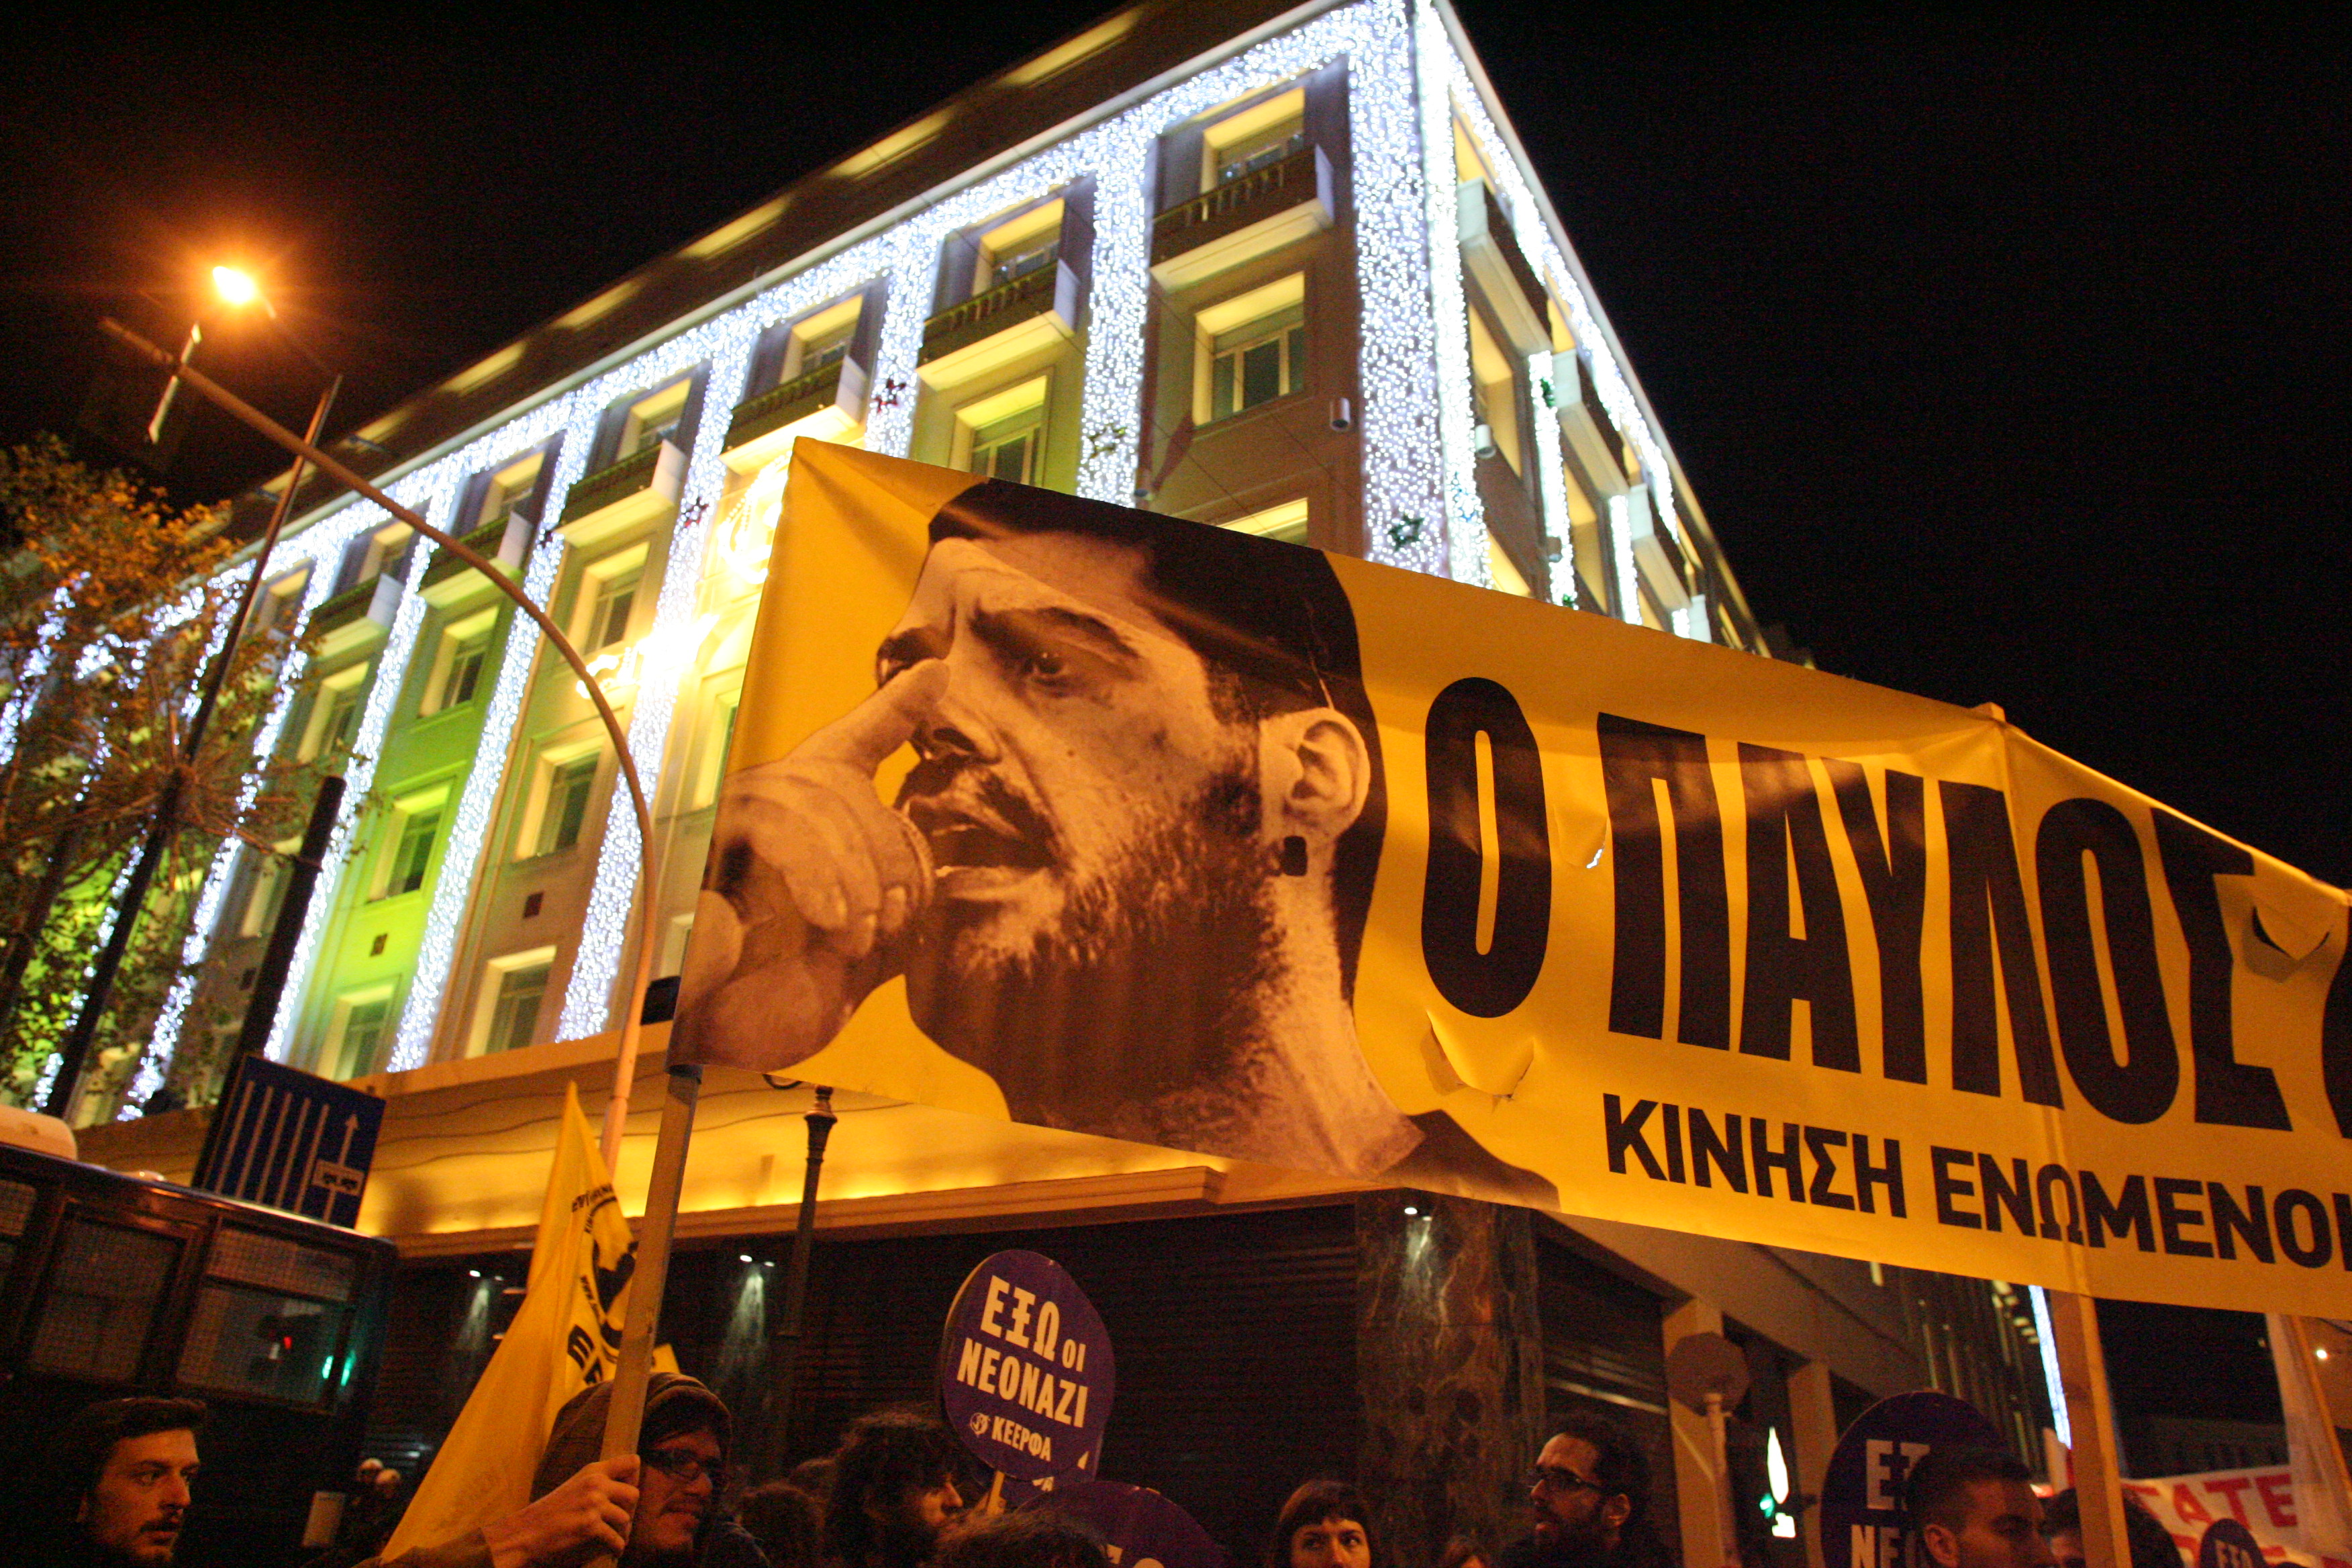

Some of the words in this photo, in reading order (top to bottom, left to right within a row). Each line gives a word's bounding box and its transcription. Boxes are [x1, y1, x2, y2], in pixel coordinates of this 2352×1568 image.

[1420, 676, 1552, 1019] Ο
[1596, 712, 2294, 1132] ΠΑΥΛΟΣ
[1602, 1093, 1908, 1219] ΚΙΝΗΣΗ
[980, 1275, 1061, 1362] ΕΞΩ
[957, 1337, 1089, 1428] ΝΕΟΝΑΖΙ
[991, 1415, 1052, 1463] ΚΕΕΡΦΑ
